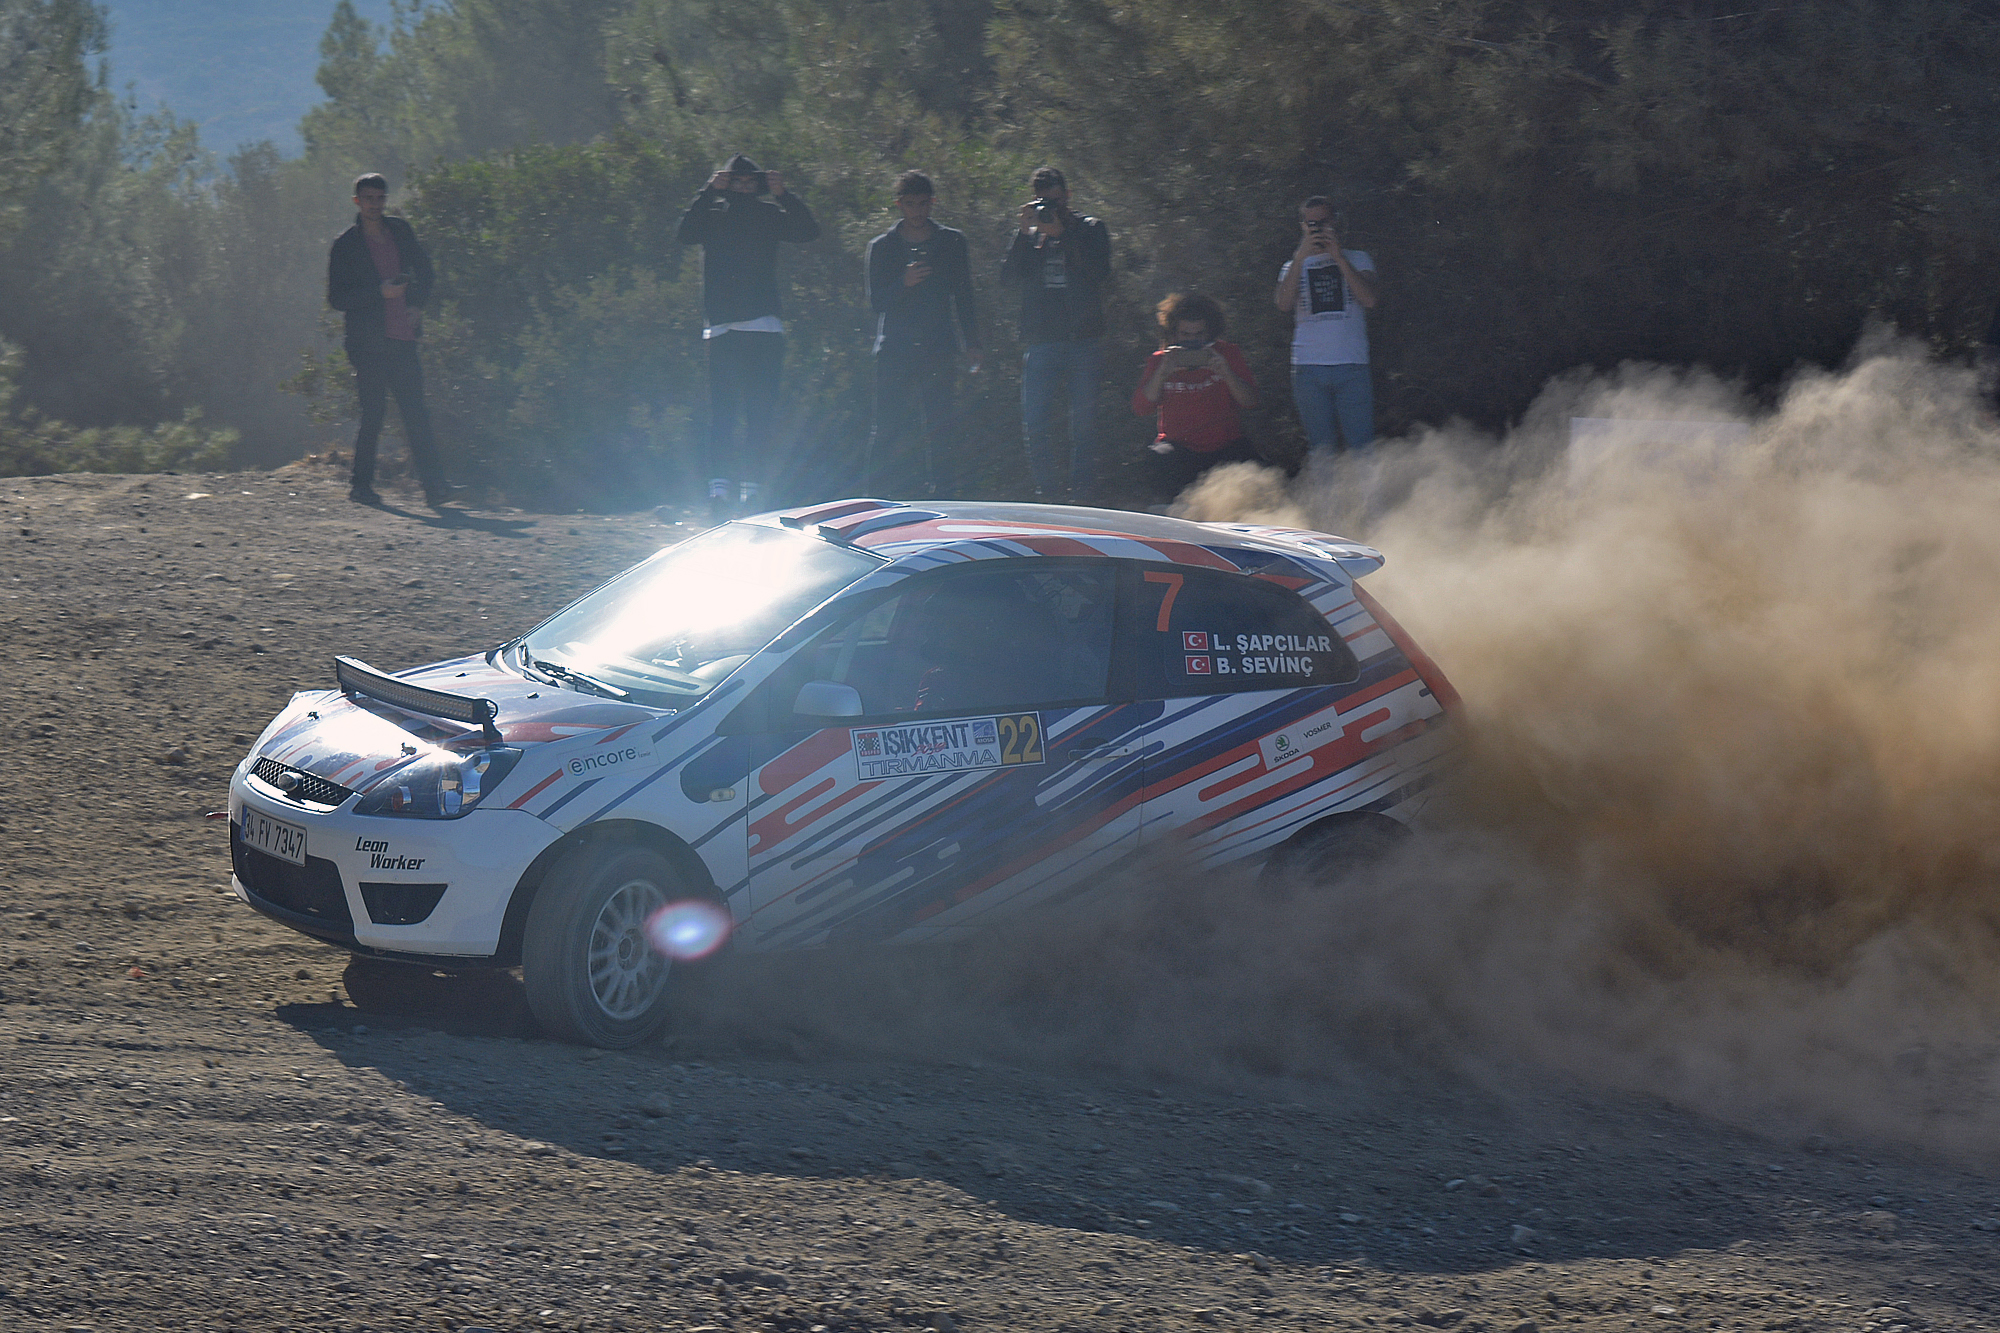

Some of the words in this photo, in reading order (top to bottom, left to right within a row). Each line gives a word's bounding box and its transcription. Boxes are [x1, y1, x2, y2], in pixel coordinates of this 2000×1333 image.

[1143, 571, 1184, 632] 7
[1213, 633, 1231, 651] L.
[1236, 633, 1332, 655] ŞAPCILAR
[1217, 657, 1237, 674] B.
[1242, 652, 1314, 678] SEVİNÇ
[883, 724, 969, 758] IŞIKKENT
[1000, 716, 1042, 764] 22
[1303, 721, 1332, 739] VOSMER
[570, 747, 637, 774] encore
[861, 749, 997, 777] TIRMANMA
[245, 813, 254, 841] 34
[259, 819, 271, 847] FY
[274, 825, 303, 858] 7347
[355, 836, 389, 854] Leon
[370, 853, 426, 871] Worker
